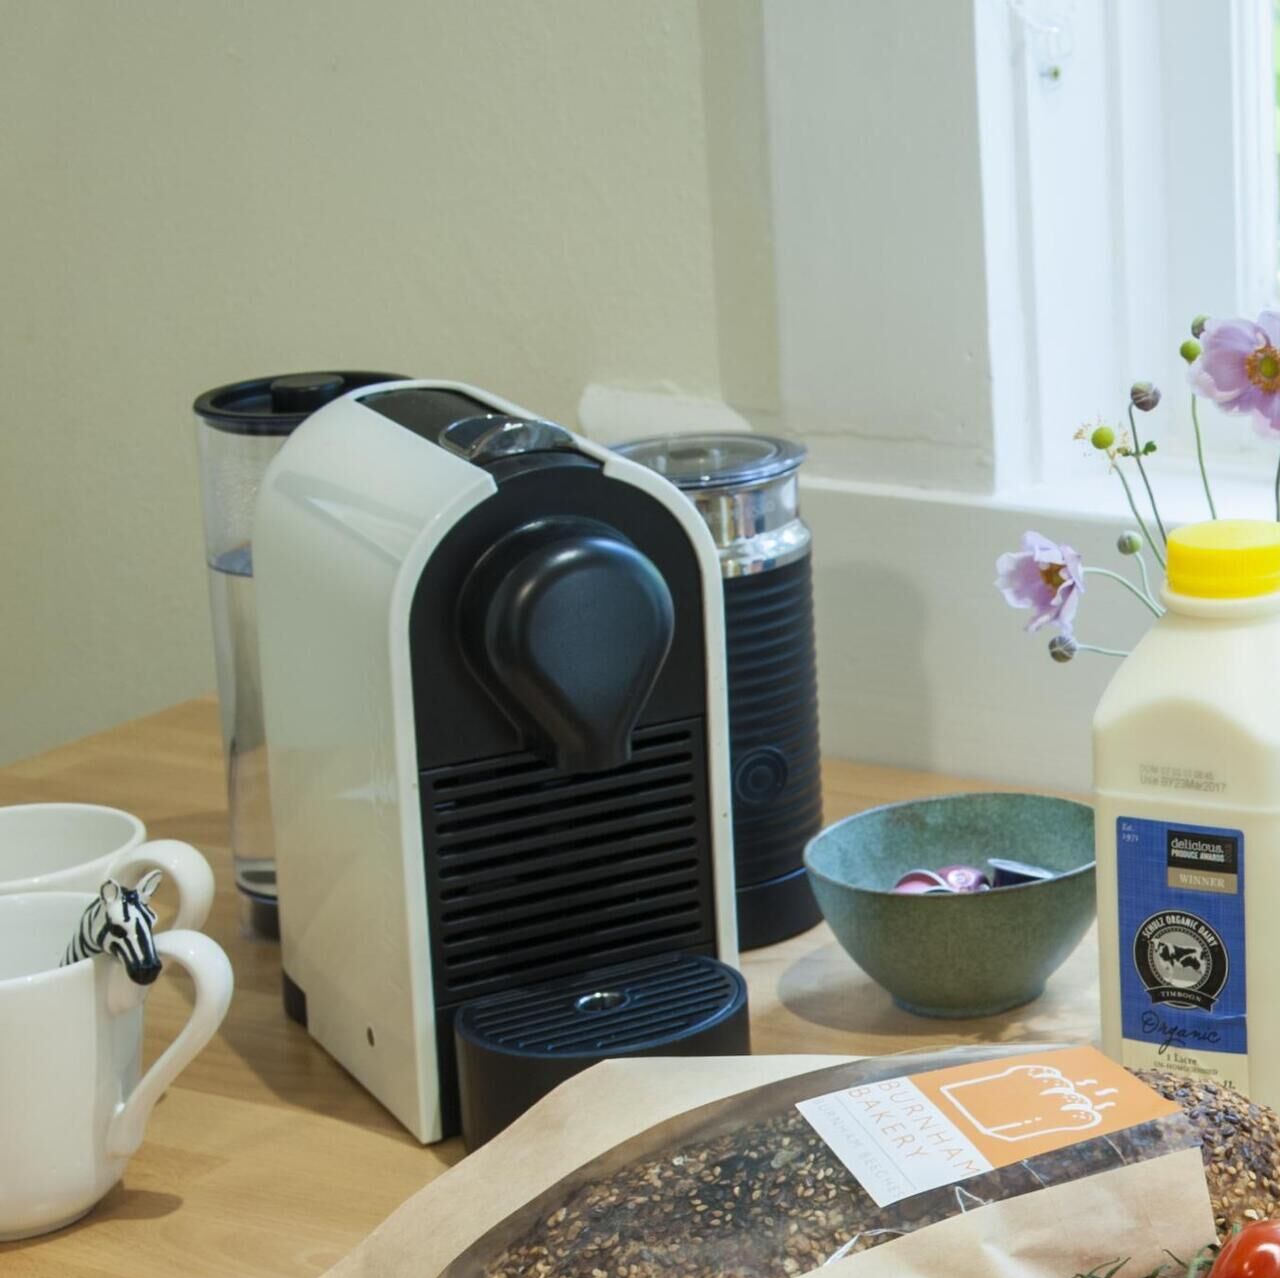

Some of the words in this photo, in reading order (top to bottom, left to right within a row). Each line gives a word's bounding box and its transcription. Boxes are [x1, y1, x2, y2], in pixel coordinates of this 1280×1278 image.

[1171, 849, 1199, 860] PRODUCE
[1200, 852, 1225, 863] AWARDS
[1179, 873, 1225, 889] WINNER
[1166, 912, 1198, 931] ORGANIC
[1141, 1011, 1222, 1055] Organic
[848, 1087, 929, 1158] BAKERY
[878, 1080, 982, 1177] BURNHAM
